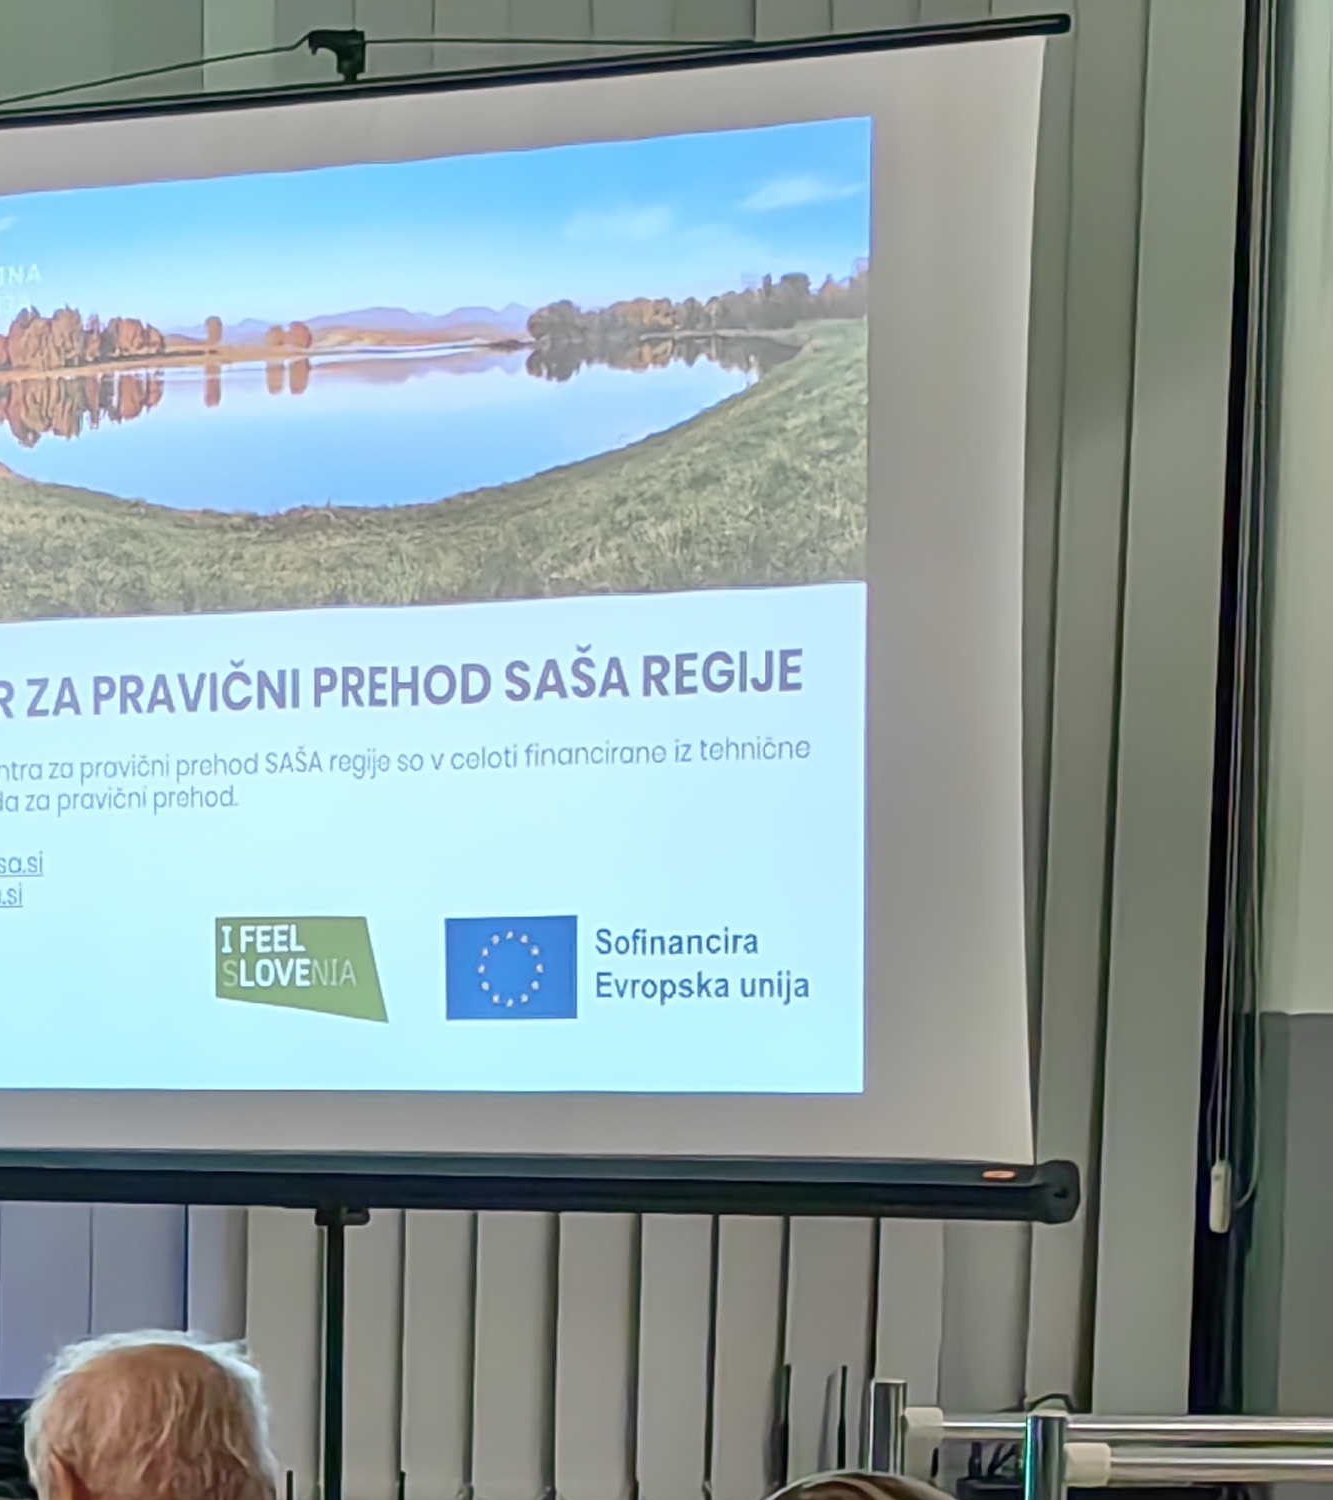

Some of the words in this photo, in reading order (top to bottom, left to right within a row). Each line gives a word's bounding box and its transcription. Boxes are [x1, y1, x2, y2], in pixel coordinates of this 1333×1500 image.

[26, 676, 82, 717] ZA
[93, 659, 300, 715] PRAVIČNI
[314, 662, 491, 708] PREHOD
[504, 644, 630, 701] SAŠA
[642, 648, 804, 697] REGIJE
[49, 761, 74, 780] za
[80, 753, 170, 786] pravični
[177, 751, 259, 784] prehod
[265, 745, 324, 774] SAŠA
[329, 747, 391, 780] regije
[397, 753, 424, 772] so
[431, 752, 445, 771] v
[450, 743, 518, 770] celoti
[674, 738, 693, 763] iz
[700, 735, 811, 762] tehnične
[25, 793, 50, 812] za
[56, 785, 147, 818] pravični
[153, 784, 239, 815] prehod.
[222, 925, 232, 954] I
[239, 923, 306, 954] FEEL
[595, 926, 759, 956] Sofinancira
[222, 957, 357, 988] SLOVENIA
[596, 970, 730, 1006] Evropska
[740, 969, 811, 1006] unija
